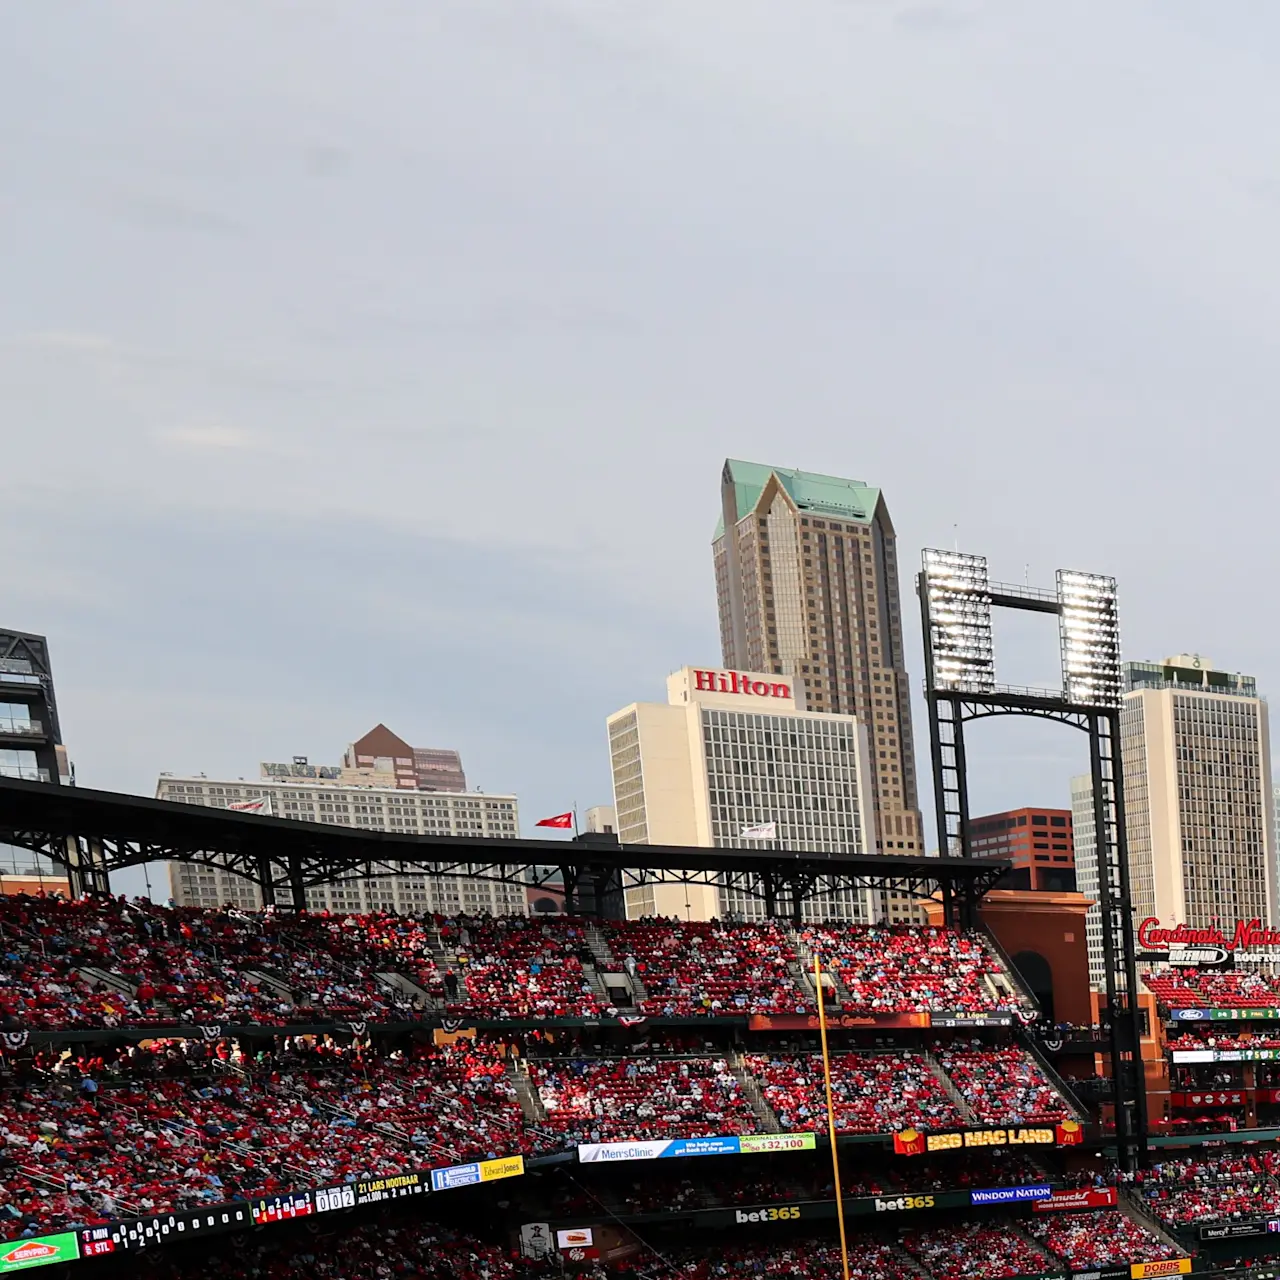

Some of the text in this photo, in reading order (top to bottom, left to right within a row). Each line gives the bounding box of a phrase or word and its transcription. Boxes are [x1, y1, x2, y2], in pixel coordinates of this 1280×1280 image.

[693, 670, 792, 699] Hilton
[1139, 917, 1225, 949] Cardinals
[1169, 950, 1219, 962] HOFFMANN
[928, 1128, 1054, 1151] BIG MAC LAND
[358, 1174, 419, 1193] 21 LARS NOOTBAAR
[972, 1190, 1014, 1202] WINDOW
[1016, 1187, 1051, 1199] NATION
[875, 1196, 935, 1211] bet365
[736, 1206, 800, 1223] bet365
[93, 1228, 108, 1240] MIN
[1208, 1228, 1226, 1237] Mercy
[95, 1242, 110, 1253] STL
[1144, 1261, 1180, 1273] DOBBS
